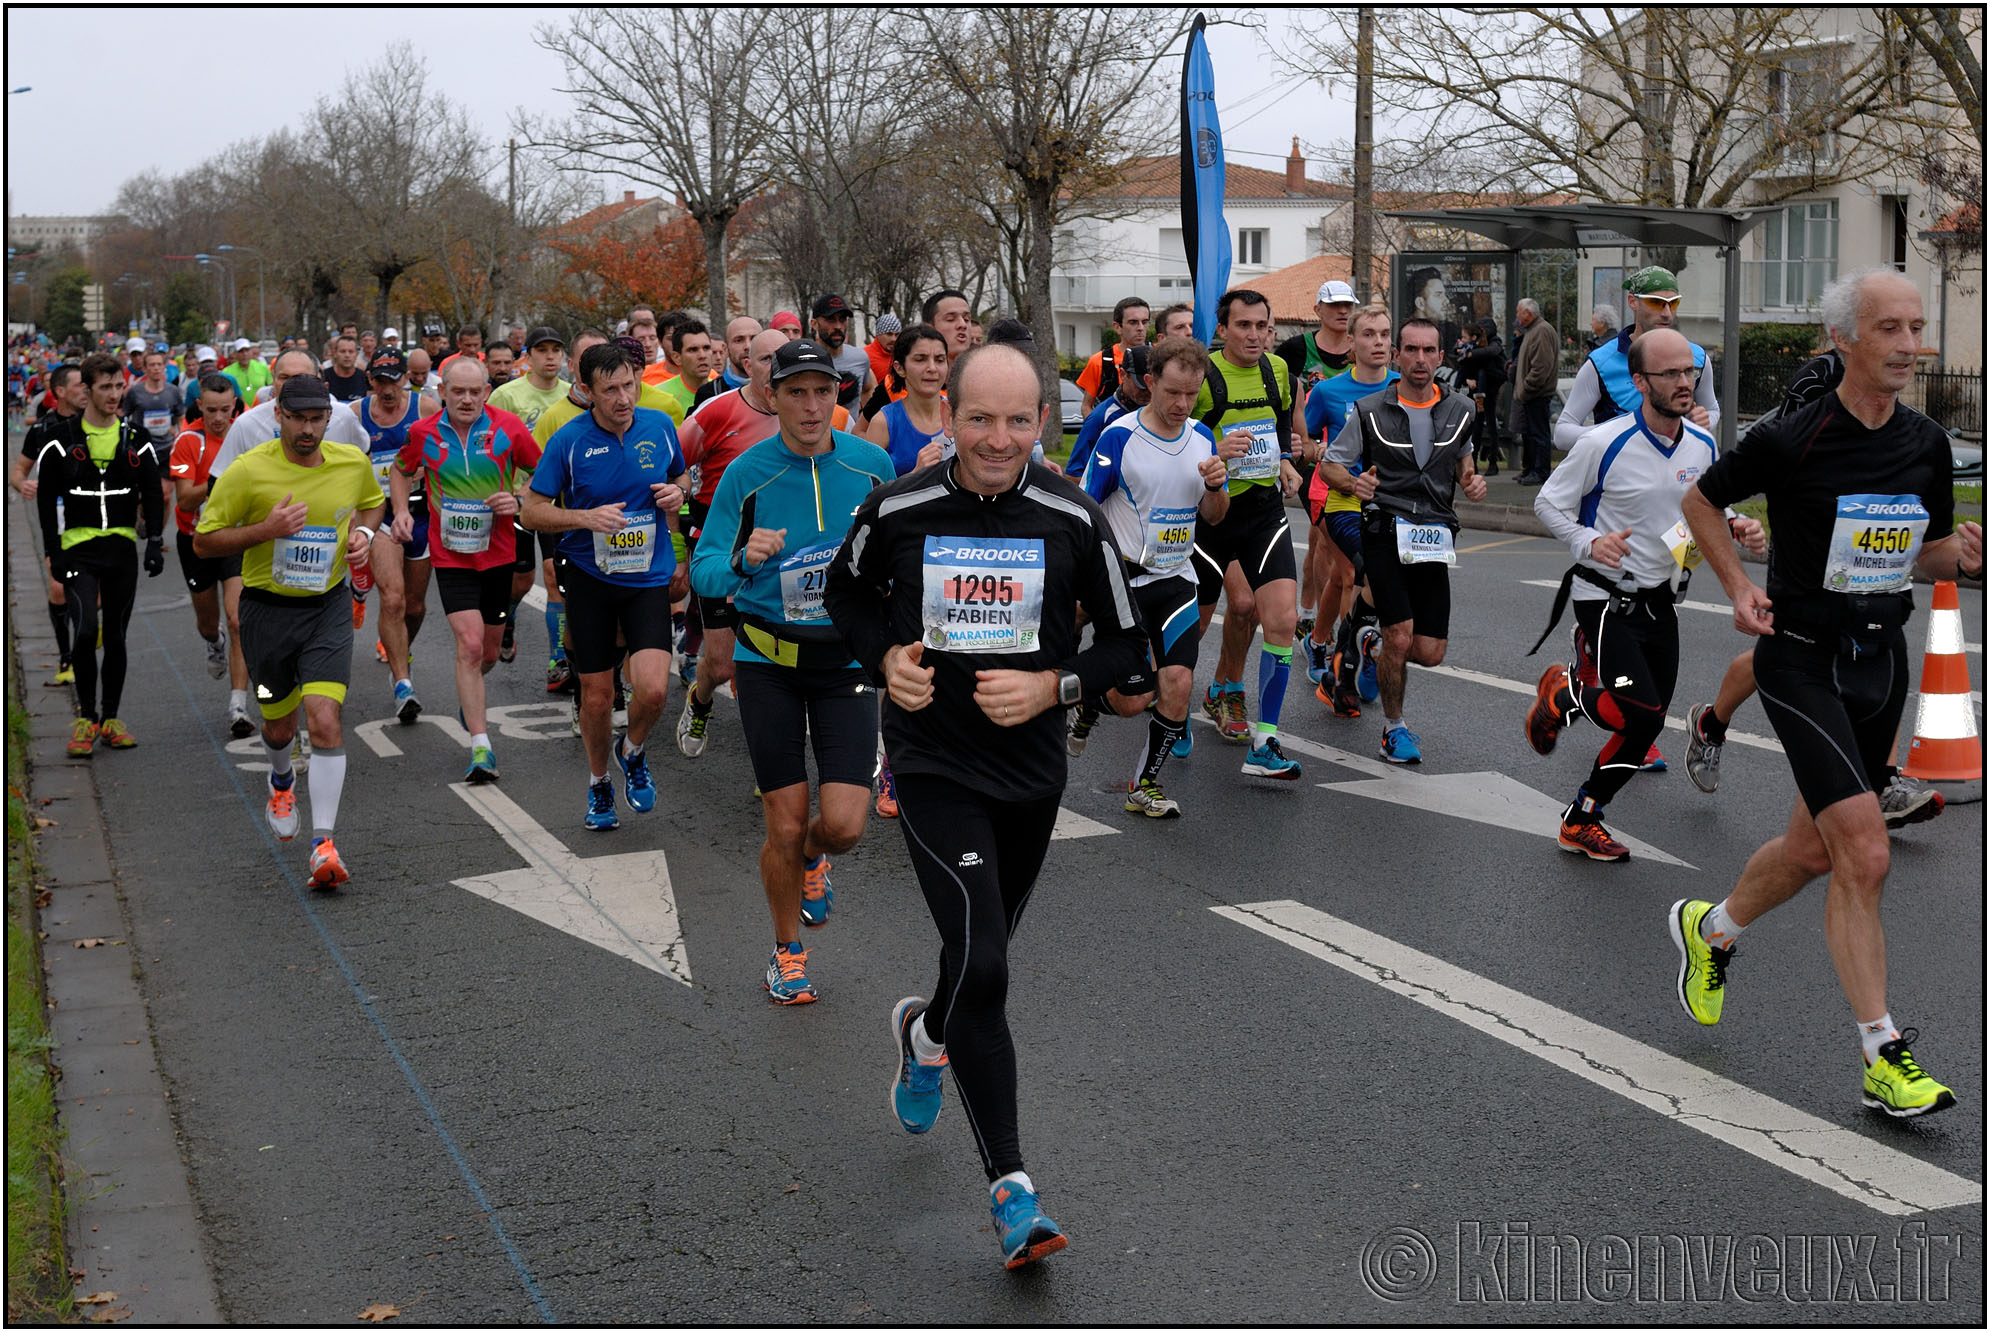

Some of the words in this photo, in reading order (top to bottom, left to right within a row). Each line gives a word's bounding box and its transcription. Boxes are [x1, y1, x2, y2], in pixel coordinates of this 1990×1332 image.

[1866, 503, 1925, 514] BROOKS
[452, 515, 479, 531] 1676
[624, 513, 653, 524] OOKS
[610, 530, 644, 549] 4398
[1163, 527, 1188, 544] 4515
[1411, 528, 1440, 545] 2282
[1858, 527, 1910, 554] 4550
[295, 546, 321, 564] 1811
[955, 548, 1040, 562] BROOKS
[1853, 556, 1887, 569] MICHEL
[803, 569, 828, 591] 27
[1851, 572, 1903, 584] MARATHON
[952, 574, 1013, 607] 1295
[803, 605, 827, 613] MAR
[947, 609, 1012, 625] FABIEN
[948, 629, 1015, 641] MARATHON
